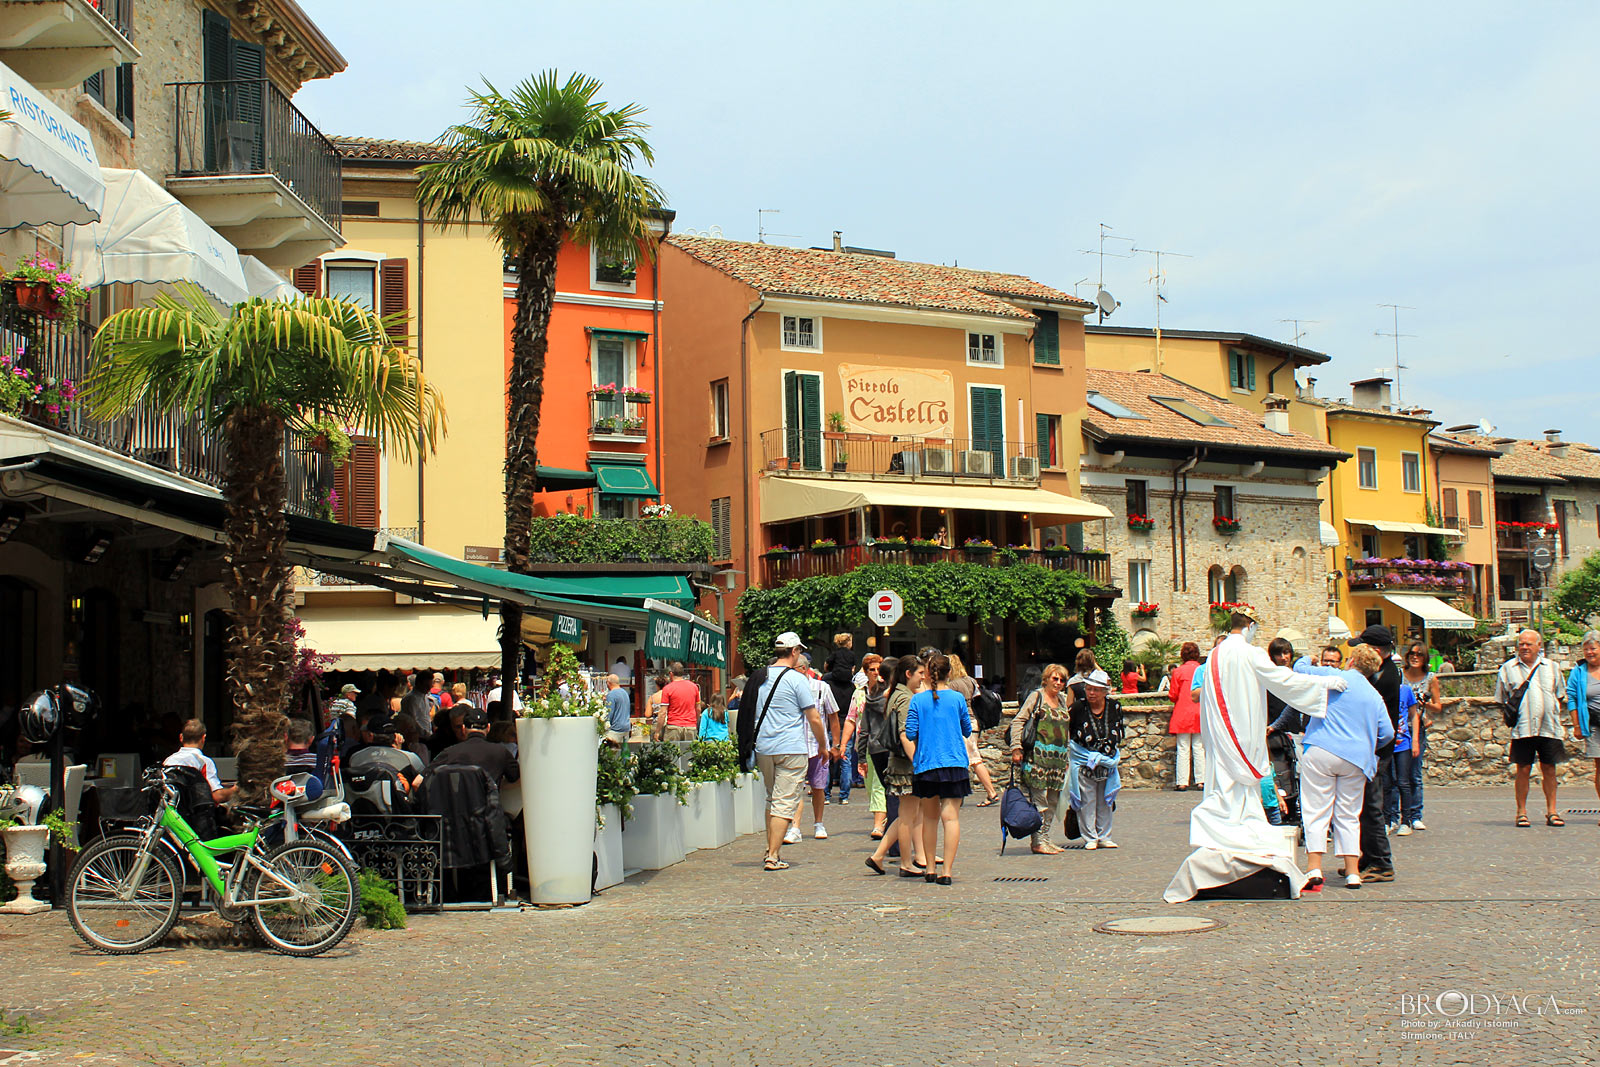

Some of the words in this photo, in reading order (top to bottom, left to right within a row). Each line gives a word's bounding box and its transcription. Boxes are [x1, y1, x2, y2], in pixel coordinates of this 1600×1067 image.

[10, 86, 93, 163] RISTORANTE
[847, 377, 899, 394] Piccolo
[849, 396, 949, 425] Castello
[557, 615, 577, 636] PIZZERIA
